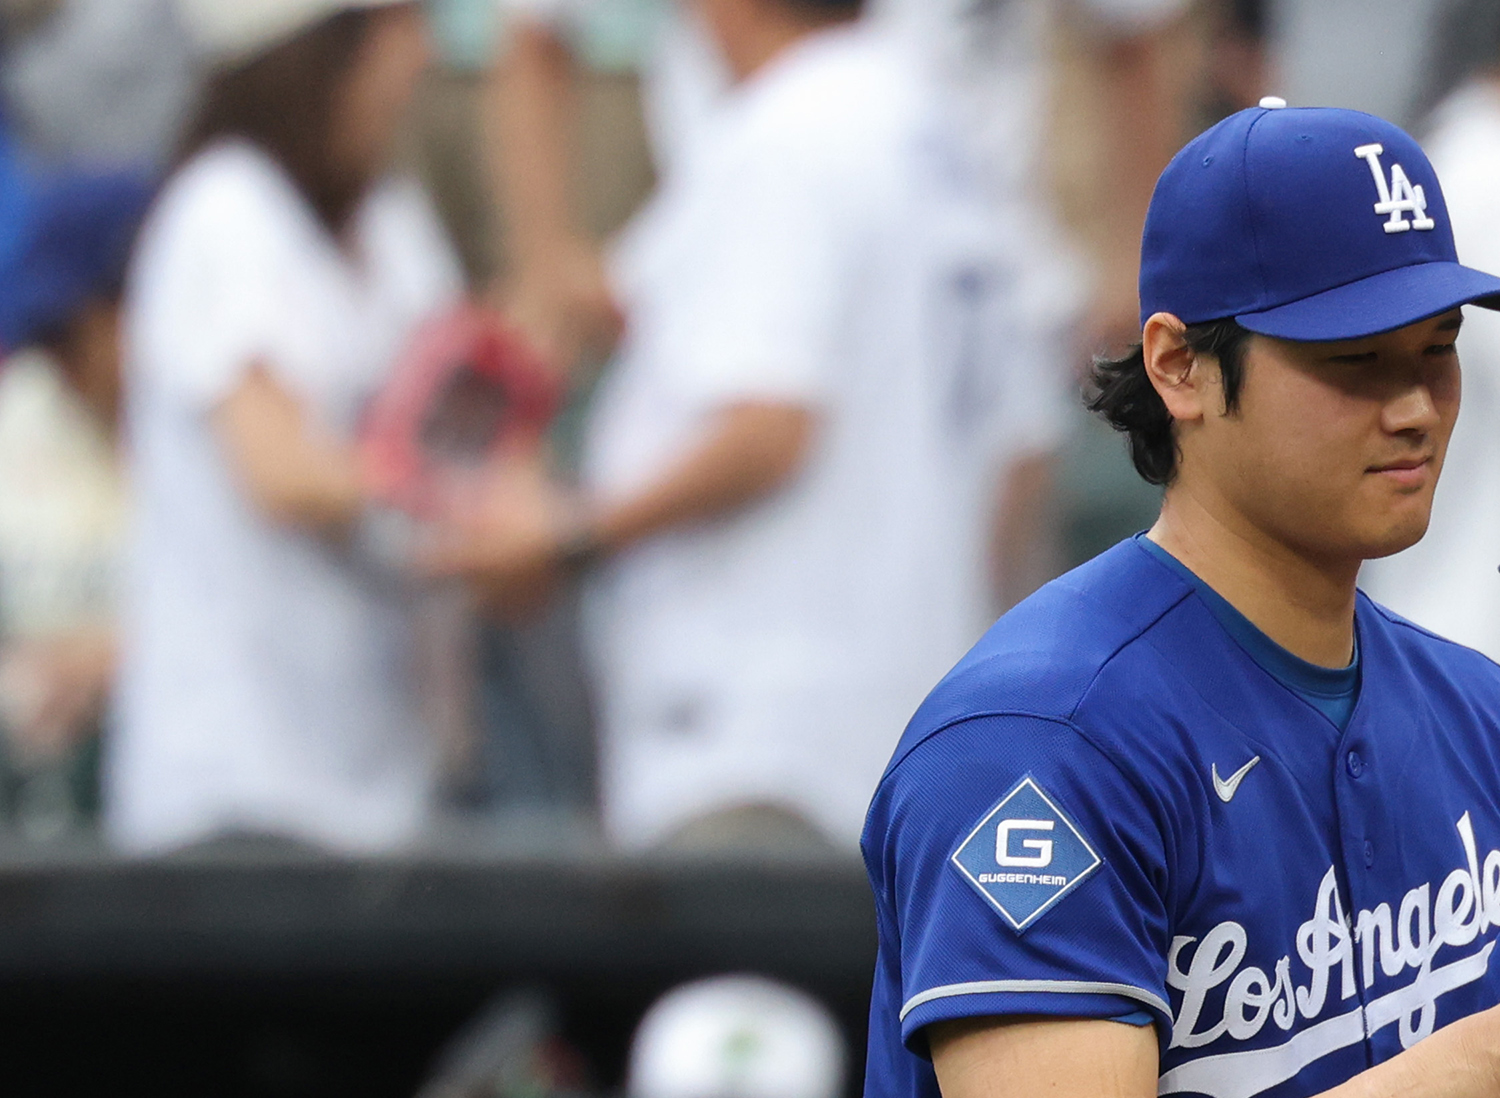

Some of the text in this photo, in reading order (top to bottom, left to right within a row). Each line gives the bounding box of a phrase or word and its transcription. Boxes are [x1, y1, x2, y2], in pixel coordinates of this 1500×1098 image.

[1354, 143, 1434, 233] LA
[995, 819, 1055, 868] G
[978, 873, 1067, 886] GUGGENHEIM
[1165, 921, 1296, 1050] Los
